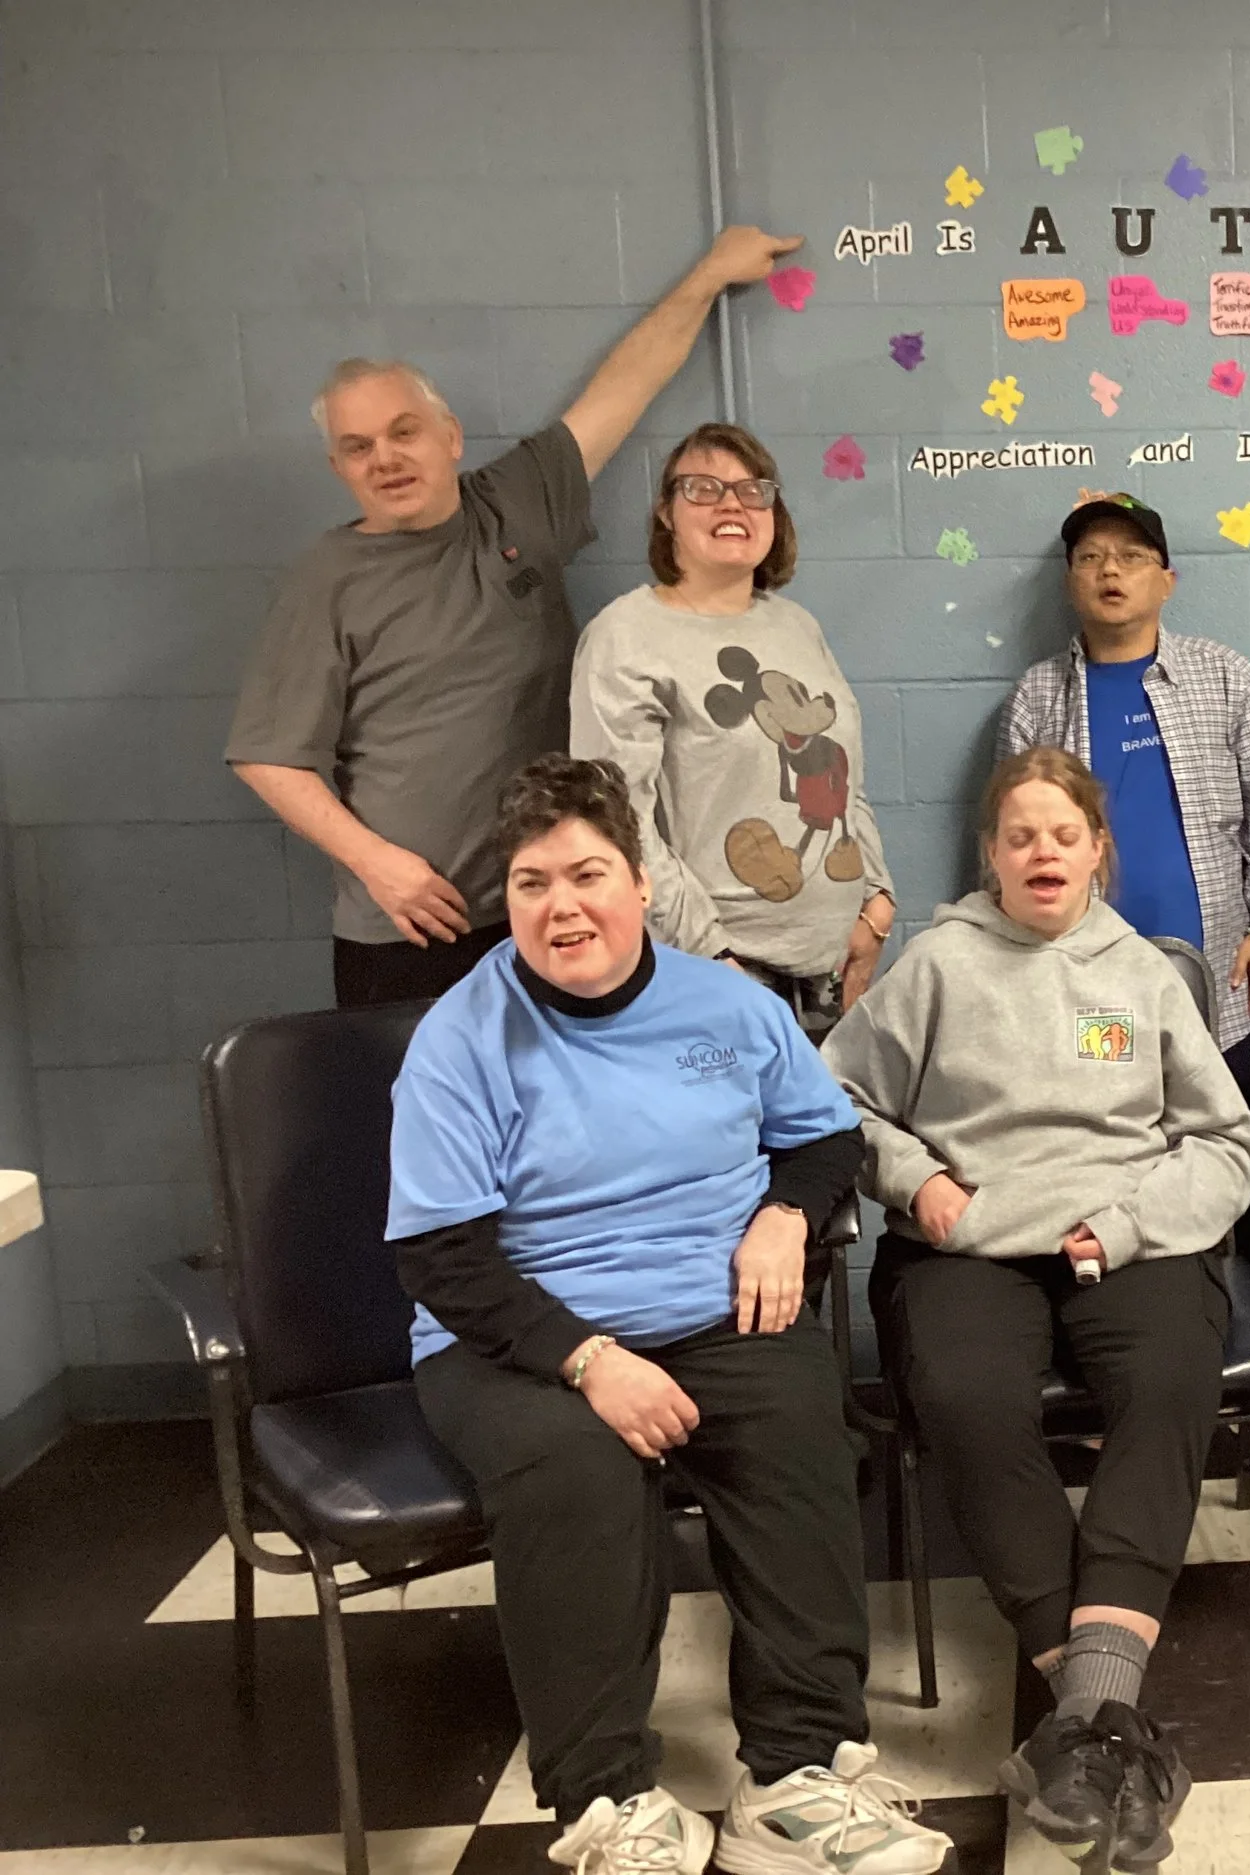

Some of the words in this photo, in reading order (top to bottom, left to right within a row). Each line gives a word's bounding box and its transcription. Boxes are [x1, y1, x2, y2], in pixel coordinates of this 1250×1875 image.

[838, 225, 909, 262] April
[940, 225, 973, 251] Is
[1008, 311, 1062, 336] Amazing
[910, 441, 1094, 478] Appreciation
[1124, 714, 1130, 725] I
[1132, 712, 1152, 724] am
[675, 1047, 738, 1071] SUNCOM
